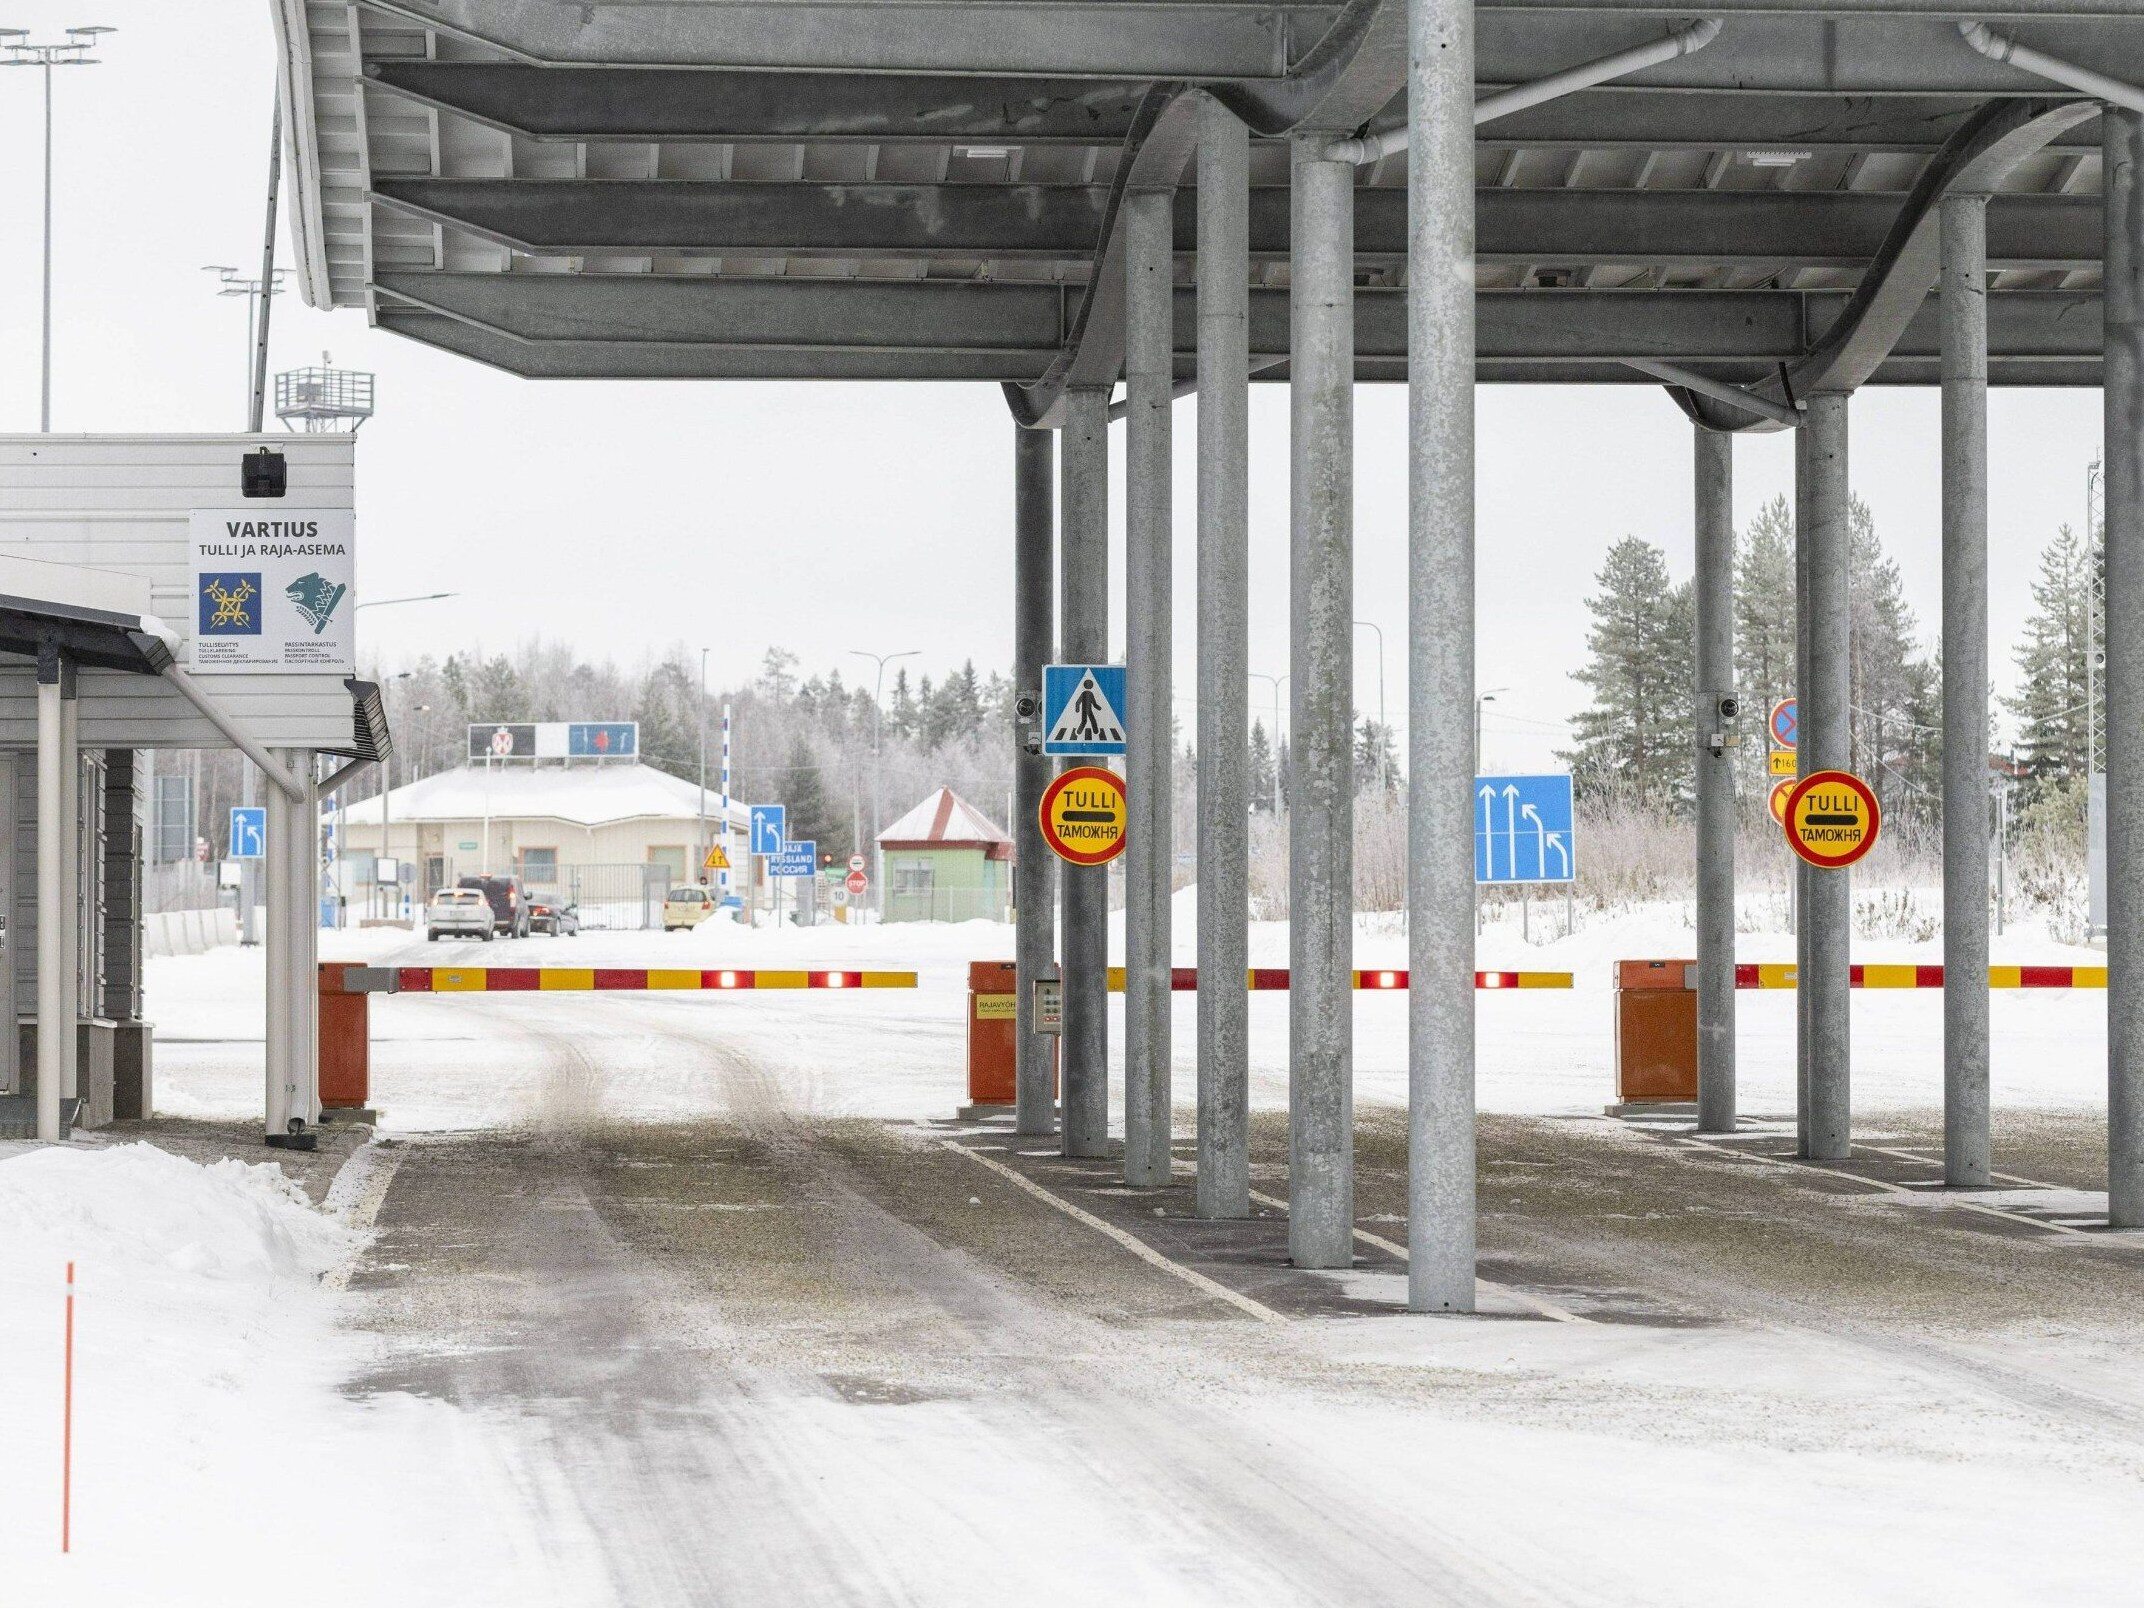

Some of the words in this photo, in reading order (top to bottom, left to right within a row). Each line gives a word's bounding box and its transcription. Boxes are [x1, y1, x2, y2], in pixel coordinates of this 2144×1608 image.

[226, 521, 318, 538] VARTIUS
[199, 544, 238, 556] TULLI
[240, 544, 256, 558] JA
[260, 544, 346, 558] RAJA-ASEMA
[1063, 791, 1116, 808] TULLI
[1806, 795, 1858, 812] TULLI
[1057, 824, 1118, 839] ТАМОЖНЯ
[1800, 828, 1861, 842] ТАМОЖНЯ
[848, 879, 866, 888] STOP
[834, 890, 845, 901] 10
